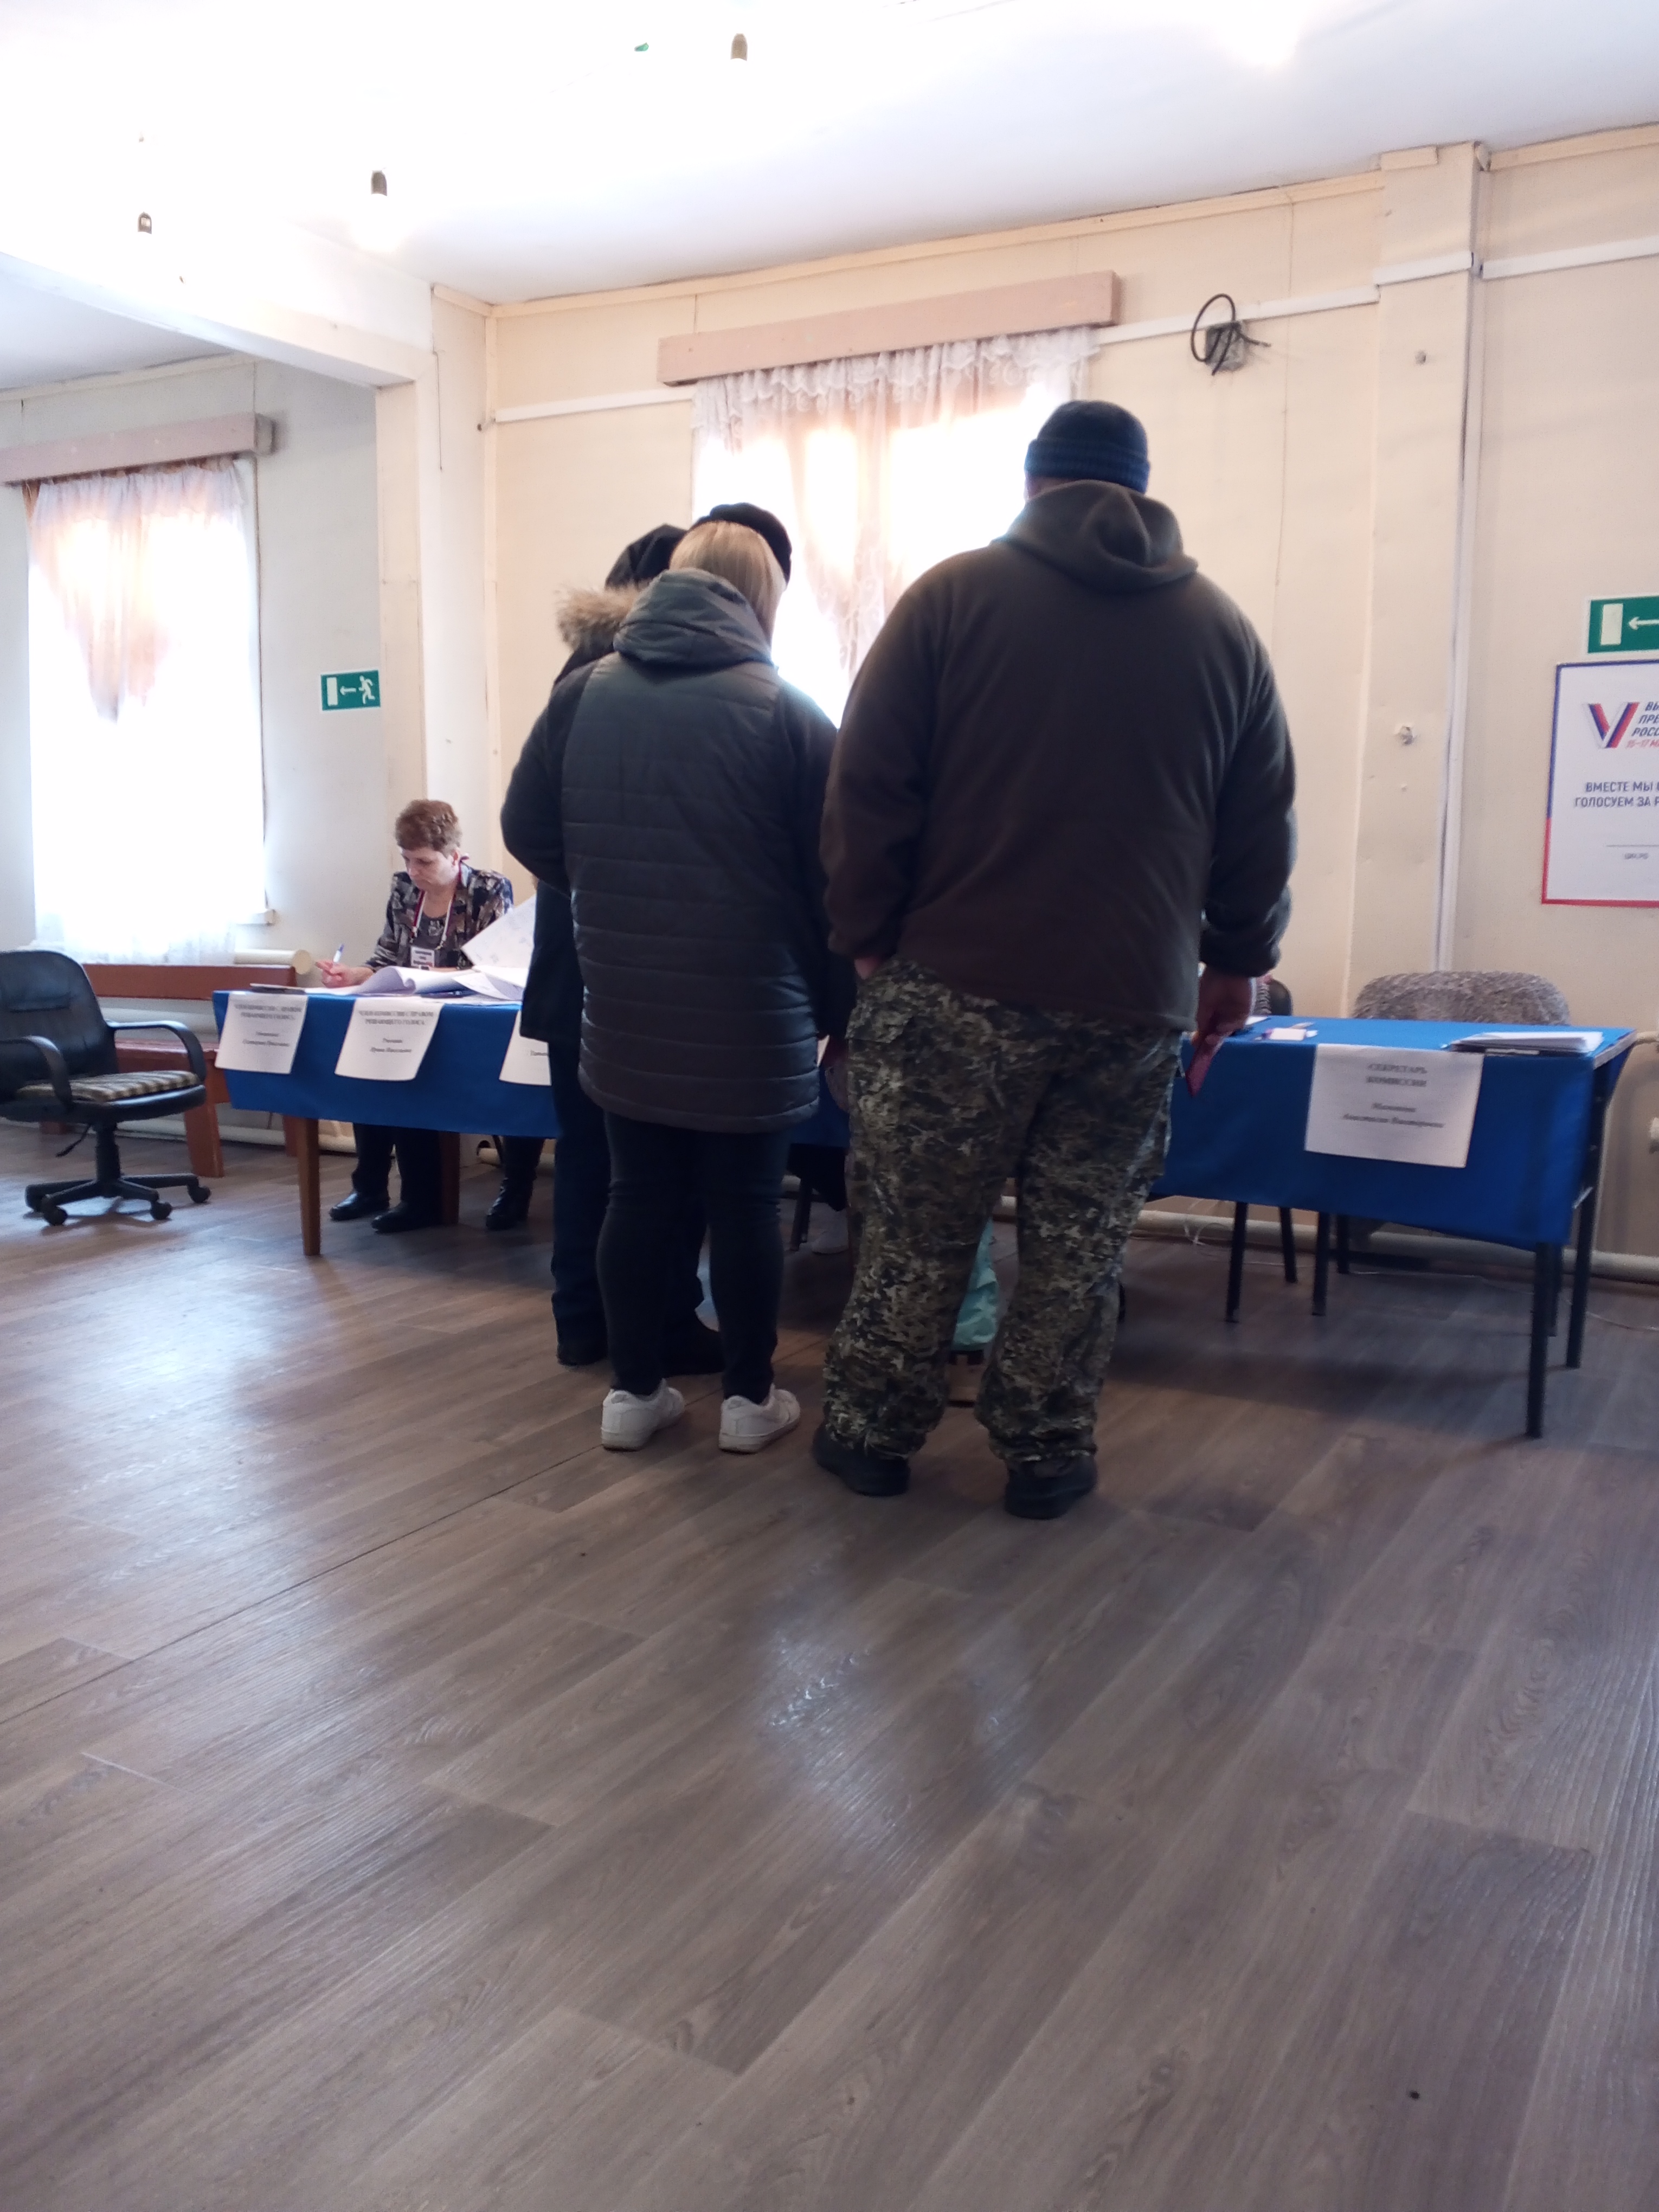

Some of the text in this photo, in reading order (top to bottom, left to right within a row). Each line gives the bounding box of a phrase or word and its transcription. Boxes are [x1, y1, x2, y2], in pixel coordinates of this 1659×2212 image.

[1585, 781, 1629, 793] ВМЕСТЕ
[1632, 781, 1653, 792] МЫ
[1575, 796, 1634, 807] ГОЛОСУЕМ
[1637, 796, 1651, 807] ЗА
